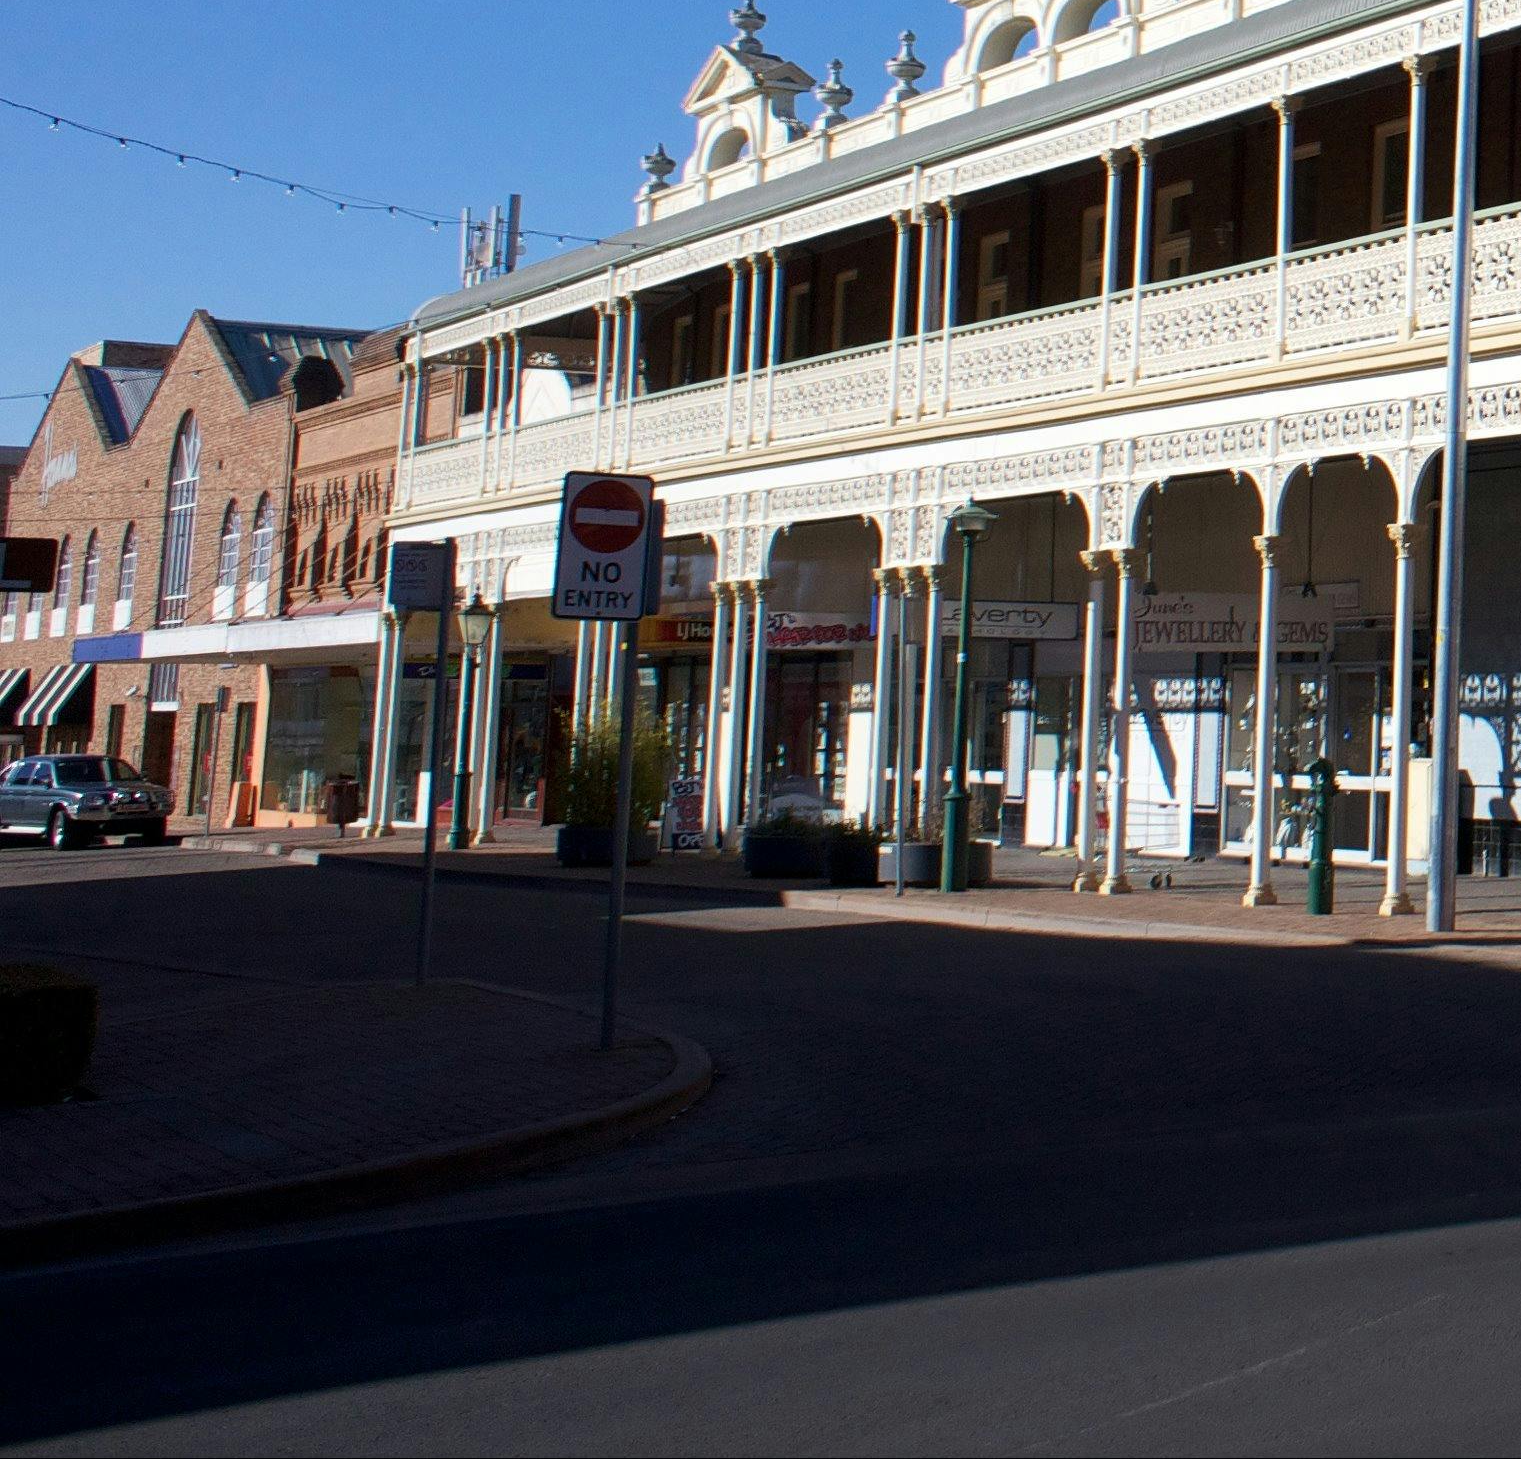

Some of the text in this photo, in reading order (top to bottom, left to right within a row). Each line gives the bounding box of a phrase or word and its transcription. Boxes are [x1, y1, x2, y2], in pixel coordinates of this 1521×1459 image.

[581, 560, 622, 584] NO
[564, 588, 634, 608] ENTRY
[1134, 595, 1195, 618] June's
[1133, 620, 1246, 649] JEWELLERY
[1277, 621, 1329, 643] GEMS
